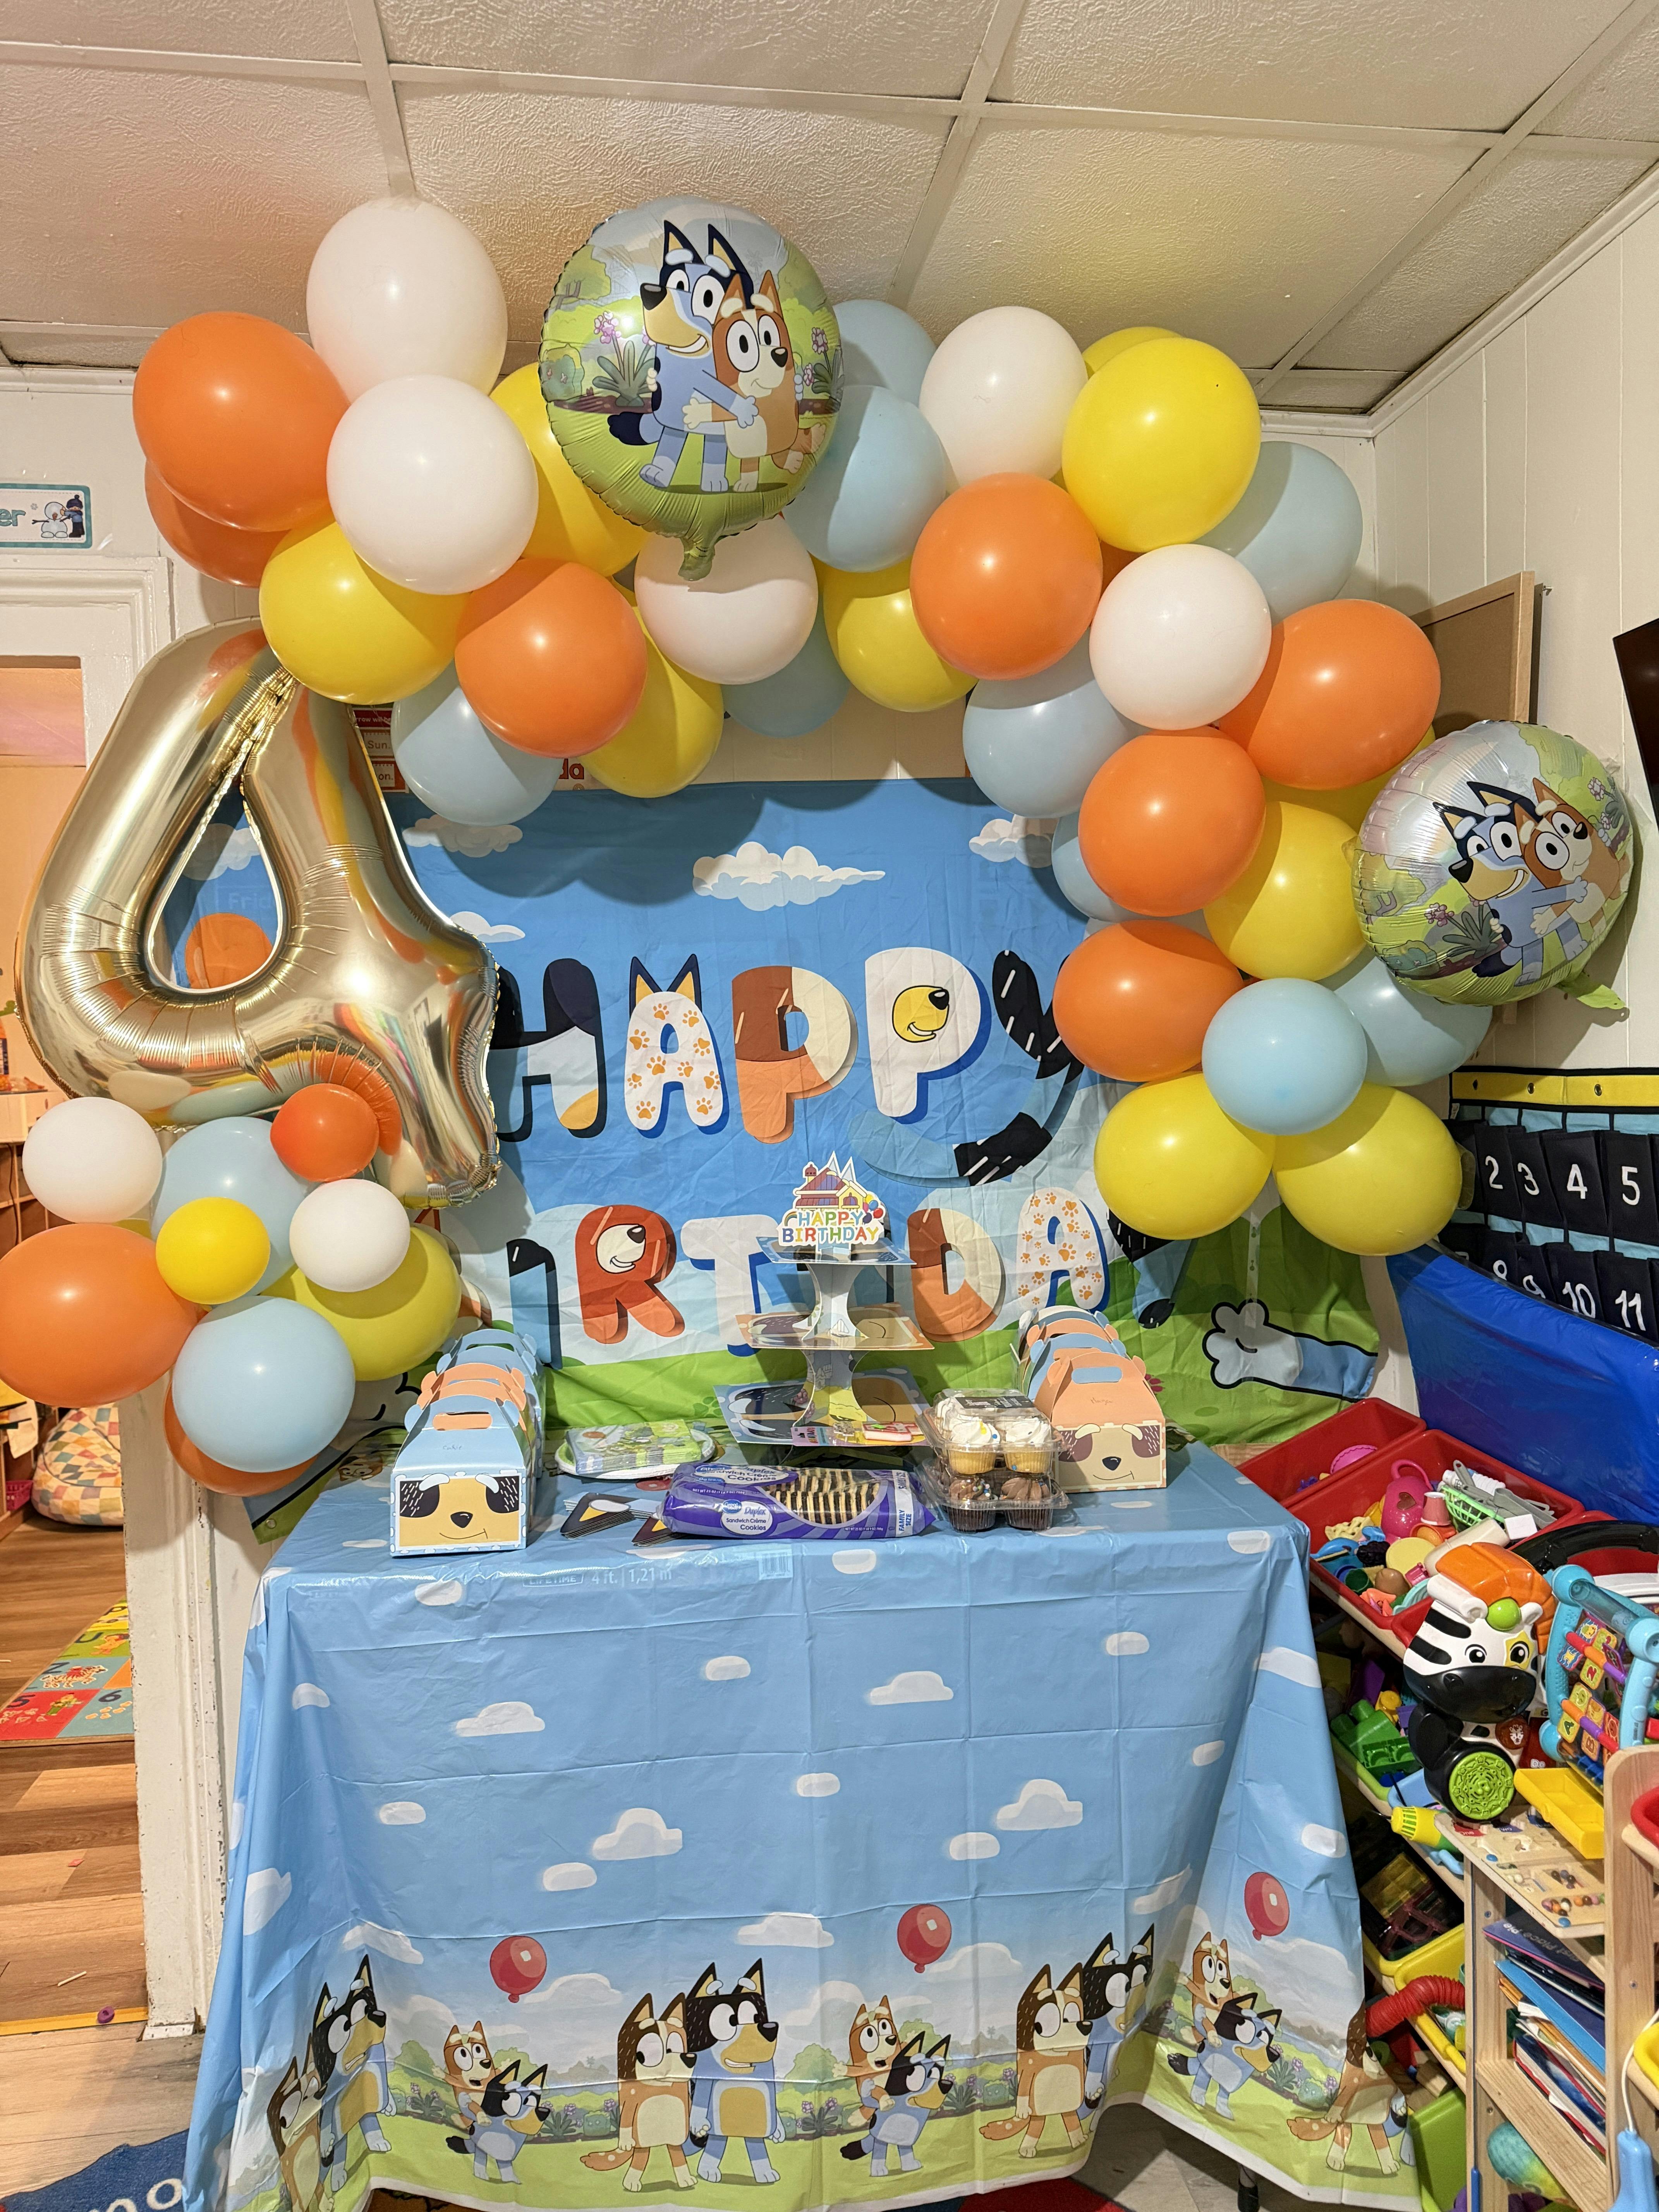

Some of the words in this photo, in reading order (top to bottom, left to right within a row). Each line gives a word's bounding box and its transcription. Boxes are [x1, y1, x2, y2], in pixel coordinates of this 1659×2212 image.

[368, 740, 390, 749] Sun.
[15, 617, 502, 1209] 4
[1485, 1156, 1503, 1189] 2
[1518, 1163, 1539, 1195] 3
[1566, 1164, 1588, 1199] 4
[1621, 1166, 1640, 1205] 5
[798, 1211, 864, 1226] HAPPY
[782, 1227, 879, 1243] BIRTHDAY
[1563, 1281, 1596, 1318] 10
[1615, 1290, 1646, 1331] 11
[744, 1506, 766, 1518] Duplex
[629, 1567, 654, 1584] 1,21
[6, 1694, 36, 1708] 5
[98, 1690, 122, 1703] 6
[1564, 1721, 1575, 1733] A
[1586, 1735, 1595, 1753] B
